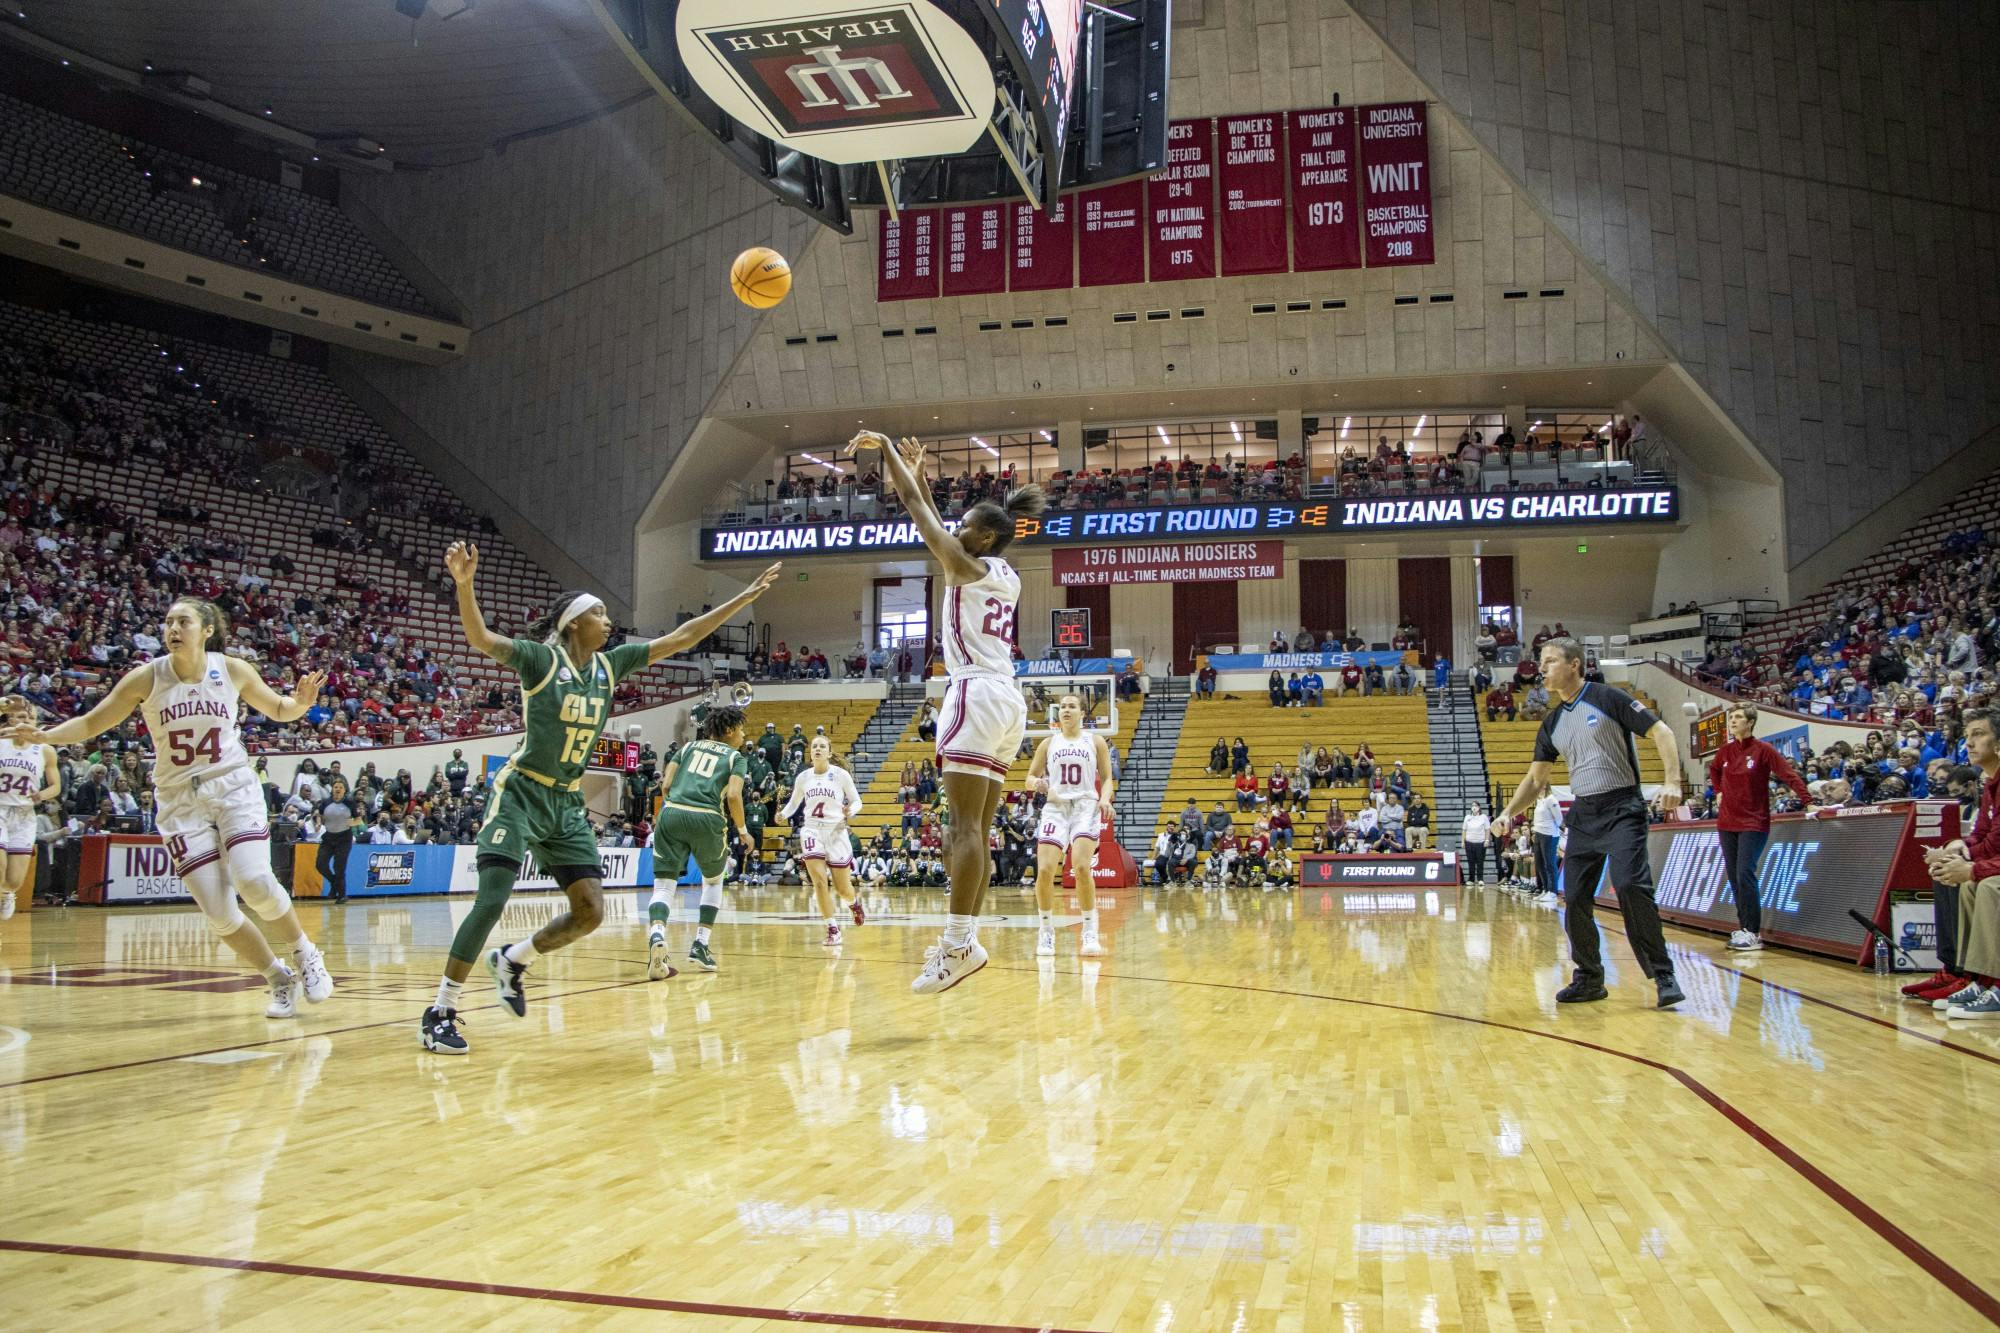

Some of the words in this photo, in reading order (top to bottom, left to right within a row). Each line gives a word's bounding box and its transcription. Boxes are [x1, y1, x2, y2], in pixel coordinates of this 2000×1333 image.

[724, 18, 901, 52] HEALTH
[1299, 112, 1344, 129] WOMEN'S
[1370, 108, 1414, 123] INDIANA
[1228, 119, 1272, 135] WOMEN'S
[1363, 122, 1422, 139] UNIVERSITY
[1231, 135, 1246, 149] BIG
[1253, 133, 1271, 148] TEN
[1312, 132, 1332, 147] AIAW
[1168, 148, 1201, 162] DEFEATED
[1227, 148, 1275, 165] CHAMPIONS
[1300, 151, 1324, 167] FINAL
[1326, 150, 1346, 164] FOUR
[1183, 164, 1210, 179] SEASON
[1301, 169, 1348, 186] APPEARANCE
[1368, 161, 1423, 193] WNIT
[1169, 181, 1192, 198] (29-0)
[1019, 205, 1033, 215] 1940
[1087, 201, 1100, 211] 1979
[1228, 200, 1245, 210] 2002
[1367, 204, 1428, 221] BASKETBALL
[1087, 211, 1100, 220] 1993
[1157, 209, 1168, 224] UPI
[1171, 207, 1205, 222] NATIONAL
[1309, 201, 1344, 226] 1973
[952, 223, 963, 232] 1981
[1018, 226, 1033, 235] 1973
[1087, 221, 1101, 231] 1997
[1160, 225, 1202, 241] CHAMPIONS
[1371, 220, 1427, 236] CHAMPIONS
[982, 230, 996, 240] 2013
[916, 246, 930, 255] 1974
[951, 242, 965, 252] 1987
[1018, 248, 1031, 257] 1981
[1387, 241, 1413, 257] 2018
[916, 257, 929, 266] 1975
[1171, 250, 1192, 264] 1975
[951, 263, 963, 272] 1991
[1342, 499, 1463, 525] INDIANA
[1470, 498, 1504, 520] VS
[1511, 492, 1671, 518] CHARLOTTE
[1082, 511, 1162, 535] FIRST
[1166, 508, 1257, 531] ROUND
[713, 528, 817, 553] INDIANA
[824, 526, 854, 547] VS
[1082, 549, 1117, 566] 1976
[1122, 546, 1180, 564] INDIANA
[1184, 544, 1256, 561] HOOSIERS
[1061, 572, 1095, 584] NCAA'S
[1097, 571, 1109, 582] #1
[1113, 569, 1157, 582] ALL-TIME
[1160, 568, 1196, 580] MARCH
[1199, 567, 1245, 579] MADNESS
[1248, 566, 1274, 578] TEAM
[982, 597, 1013, 645] 22
[1059, 624, 1082, 644] 26
[1027, 660, 1069, 673] MARCH
[1262, 654, 1323, 668] MADNESS
[159, 701, 230, 726] INDIANA
[560, 693, 605, 725] CLT
[168, 728, 221, 766] 54
[560, 727, 595, 764] 13
[692, 741, 729, 755] LAWRENCE
[1053, 748, 1090, 762] INDIANA
[0, 758, 37, 775] NDIANA
[688, 751, 719, 778] 10
[1060, 764, 1081, 785] 10
[0, 773, 30, 795] 34
[806, 788, 836, 800] NDIANA
[812, 802, 825, 818] 4
[376, 855, 402, 867] MARCH
[379, 868, 412, 880] MADNESS
[1343, 867, 1377, 876] FIRST
[1377, 867, 1415, 876] ROUND
[1759, 842, 1820, 912] ONE
[136, 878, 190, 895] BASKET
